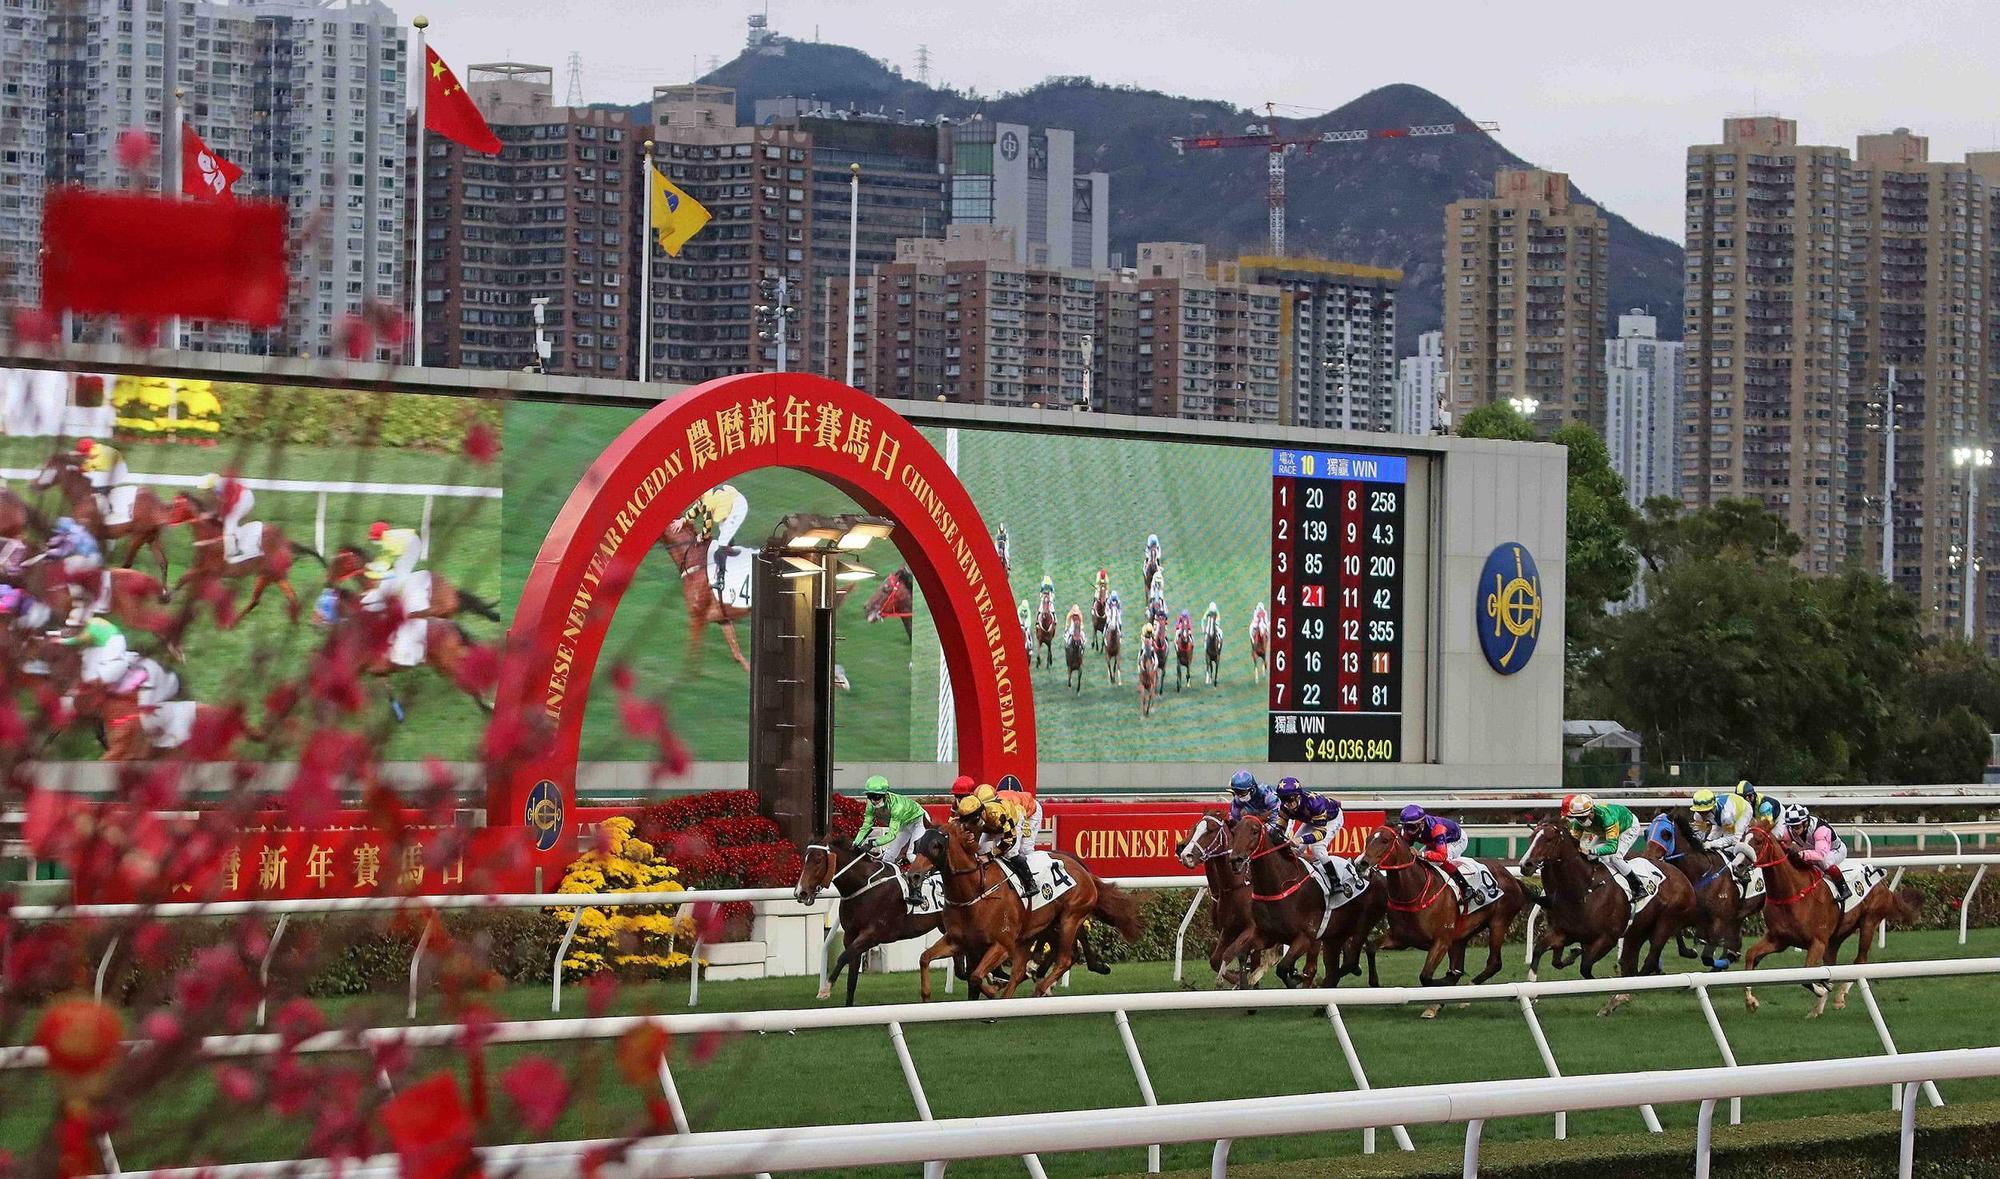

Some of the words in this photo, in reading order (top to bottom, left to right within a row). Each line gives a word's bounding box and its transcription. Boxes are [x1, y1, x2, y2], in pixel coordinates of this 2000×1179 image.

[685, 394, 900, 481] 農曆新年賽馬日
[1278, 464, 1297, 475] RACE
[1301, 454, 1315, 476] 10
[1352, 460, 1377, 478] WIN
[1279, 486, 1287, 507] 1
[1305, 487, 1324, 509] 20
[1347, 490, 1357, 511] 8
[1370, 491, 1397, 513] 258
[1278, 518, 1288, 540] 2
[1302, 520, 1328, 542] 139
[1347, 522, 1357, 543] 9
[1372, 523, 1394, 545] 4.3
[1277, 552, 1288, 573] 3
[1304, 553, 1323, 574] 85
[1343, 555, 1360, 576] 10
[1369, 555, 1396, 577] 200
[545, 642, 575, 721] INESE
[562, 582, 594, 645] NEW
[584, 527, 623, 588] YEAR
[614, 448, 685, 535] RACEDAY
[739, 573, 751, 606] 4
[901, 464, 960, 545] CHINESE
[952, 535, 984, 587] NEW
[974, 583, 1001, 648] YEAR
[991, 644, 1018, 755] RACEDAY
[1276, 585, 1287, 605] 4
[1302, 585, 1324, 607] 2.1
[1343, 587, 1358, 608] 11
[1372, 588, 1391, 610] 42
[1276, 617, 1287, 639] 5
[1301, 618, 1324, 640] 4.9
[1342, 619, 1359, 641] 12
[1368, 620, 1395, 642] 355
[1276, 650, 1286, 672] 6
[1304, 650, 1322, 672] 16
[1341, 652, 1359, 673] 13
[1373, 652, 1389, 674] 11
[1275, 683, 1286, 705] 7
[1302, 683, 1321, 705] 22
[1341, 684, 1358, 705] 14
[1372, 685, 1388, 706] 81
[1299, 715, 1326, 734] WIN
[1305, 737, 1315, 761] $
[1317, 738, 1393, 762] 49,036,840
[1074, 829, 1170, 860] CHINESE
[1050, 861, 1073, 887] 4
[1480, 870, 1499, 899] 9
